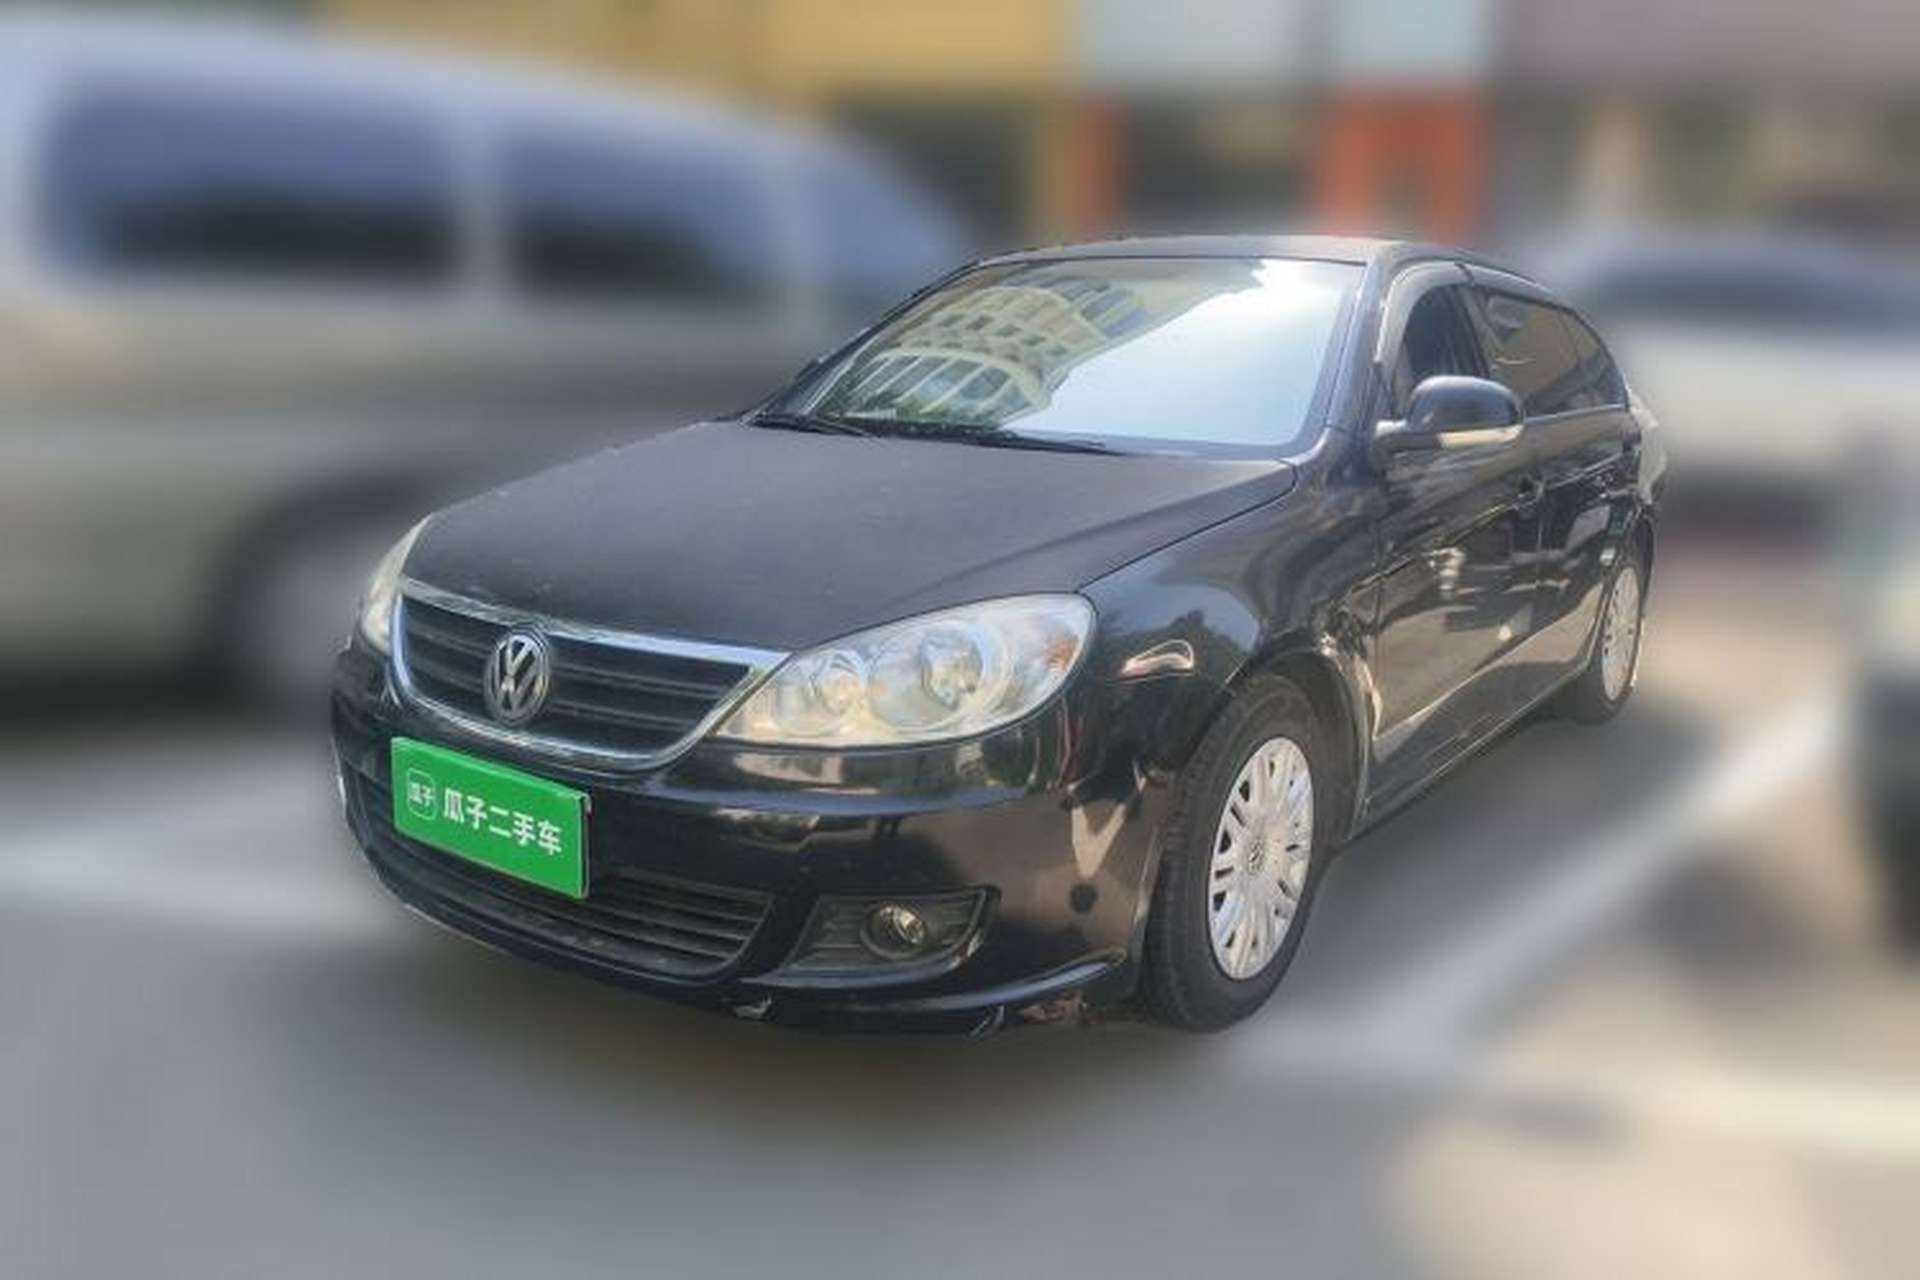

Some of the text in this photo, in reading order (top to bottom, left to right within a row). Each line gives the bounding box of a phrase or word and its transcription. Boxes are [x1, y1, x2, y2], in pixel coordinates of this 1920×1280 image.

[493, 632, 547, 715] VW
[444, 787, 561, 856] 瓜子二手车
